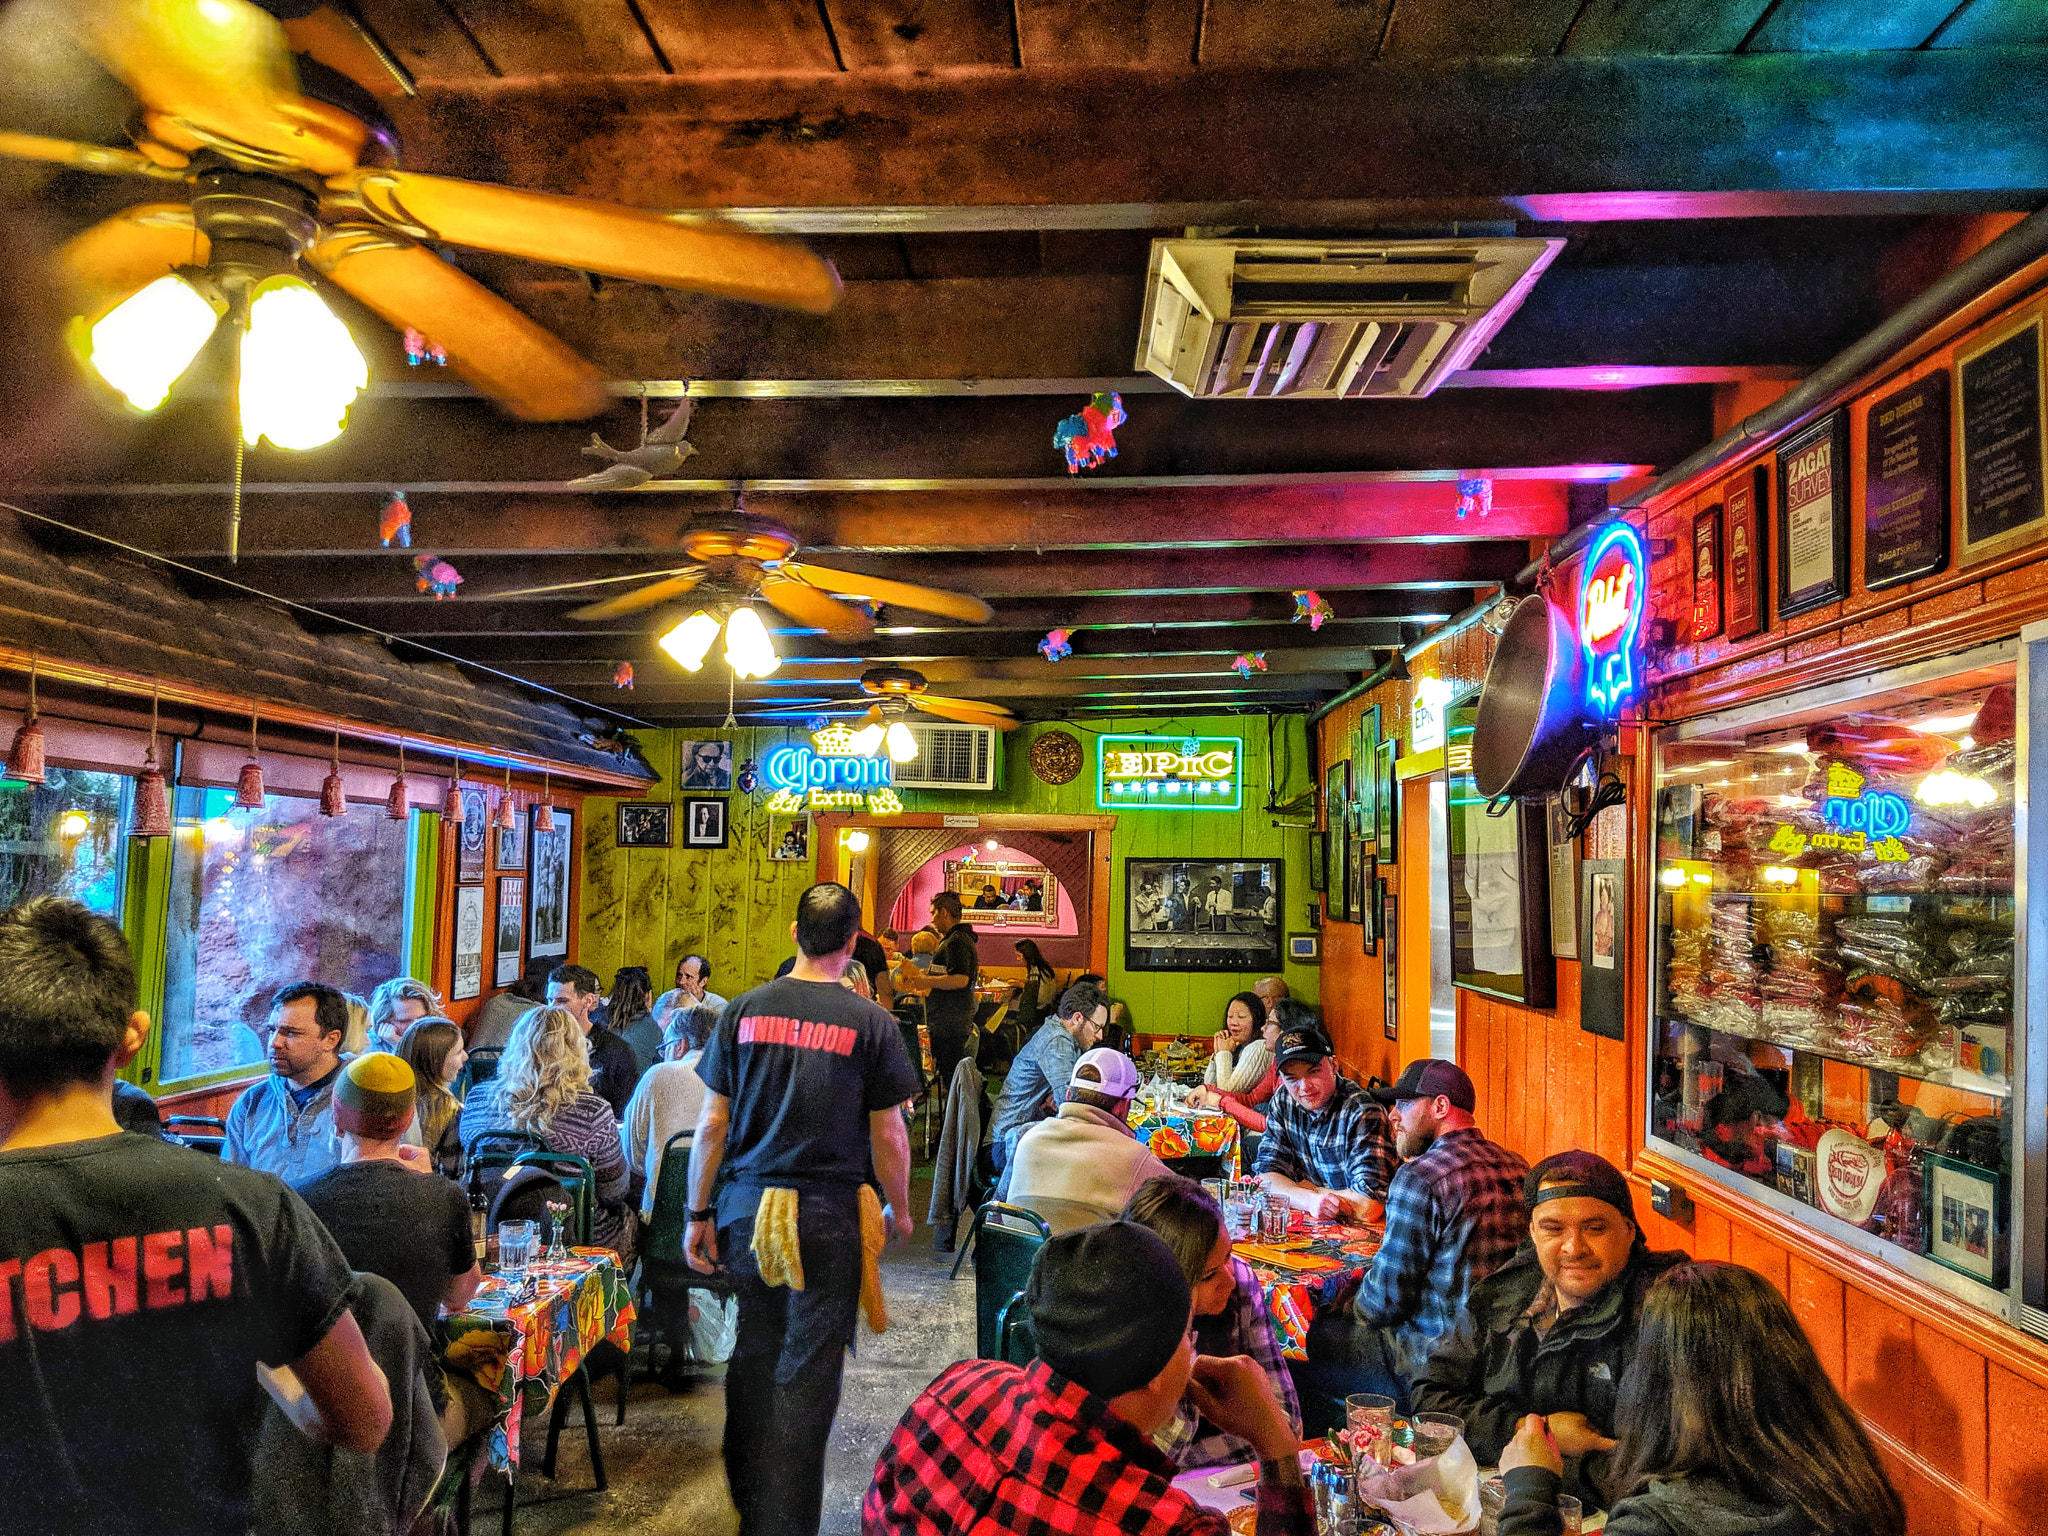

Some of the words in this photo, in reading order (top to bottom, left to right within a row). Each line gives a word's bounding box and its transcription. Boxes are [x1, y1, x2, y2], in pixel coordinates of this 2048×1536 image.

[1788, 442, 1831, 485] ZAGAT
[1789, 467, 1832, 507] SURVEY
[799, 1021, 858, 1056] ROOM
